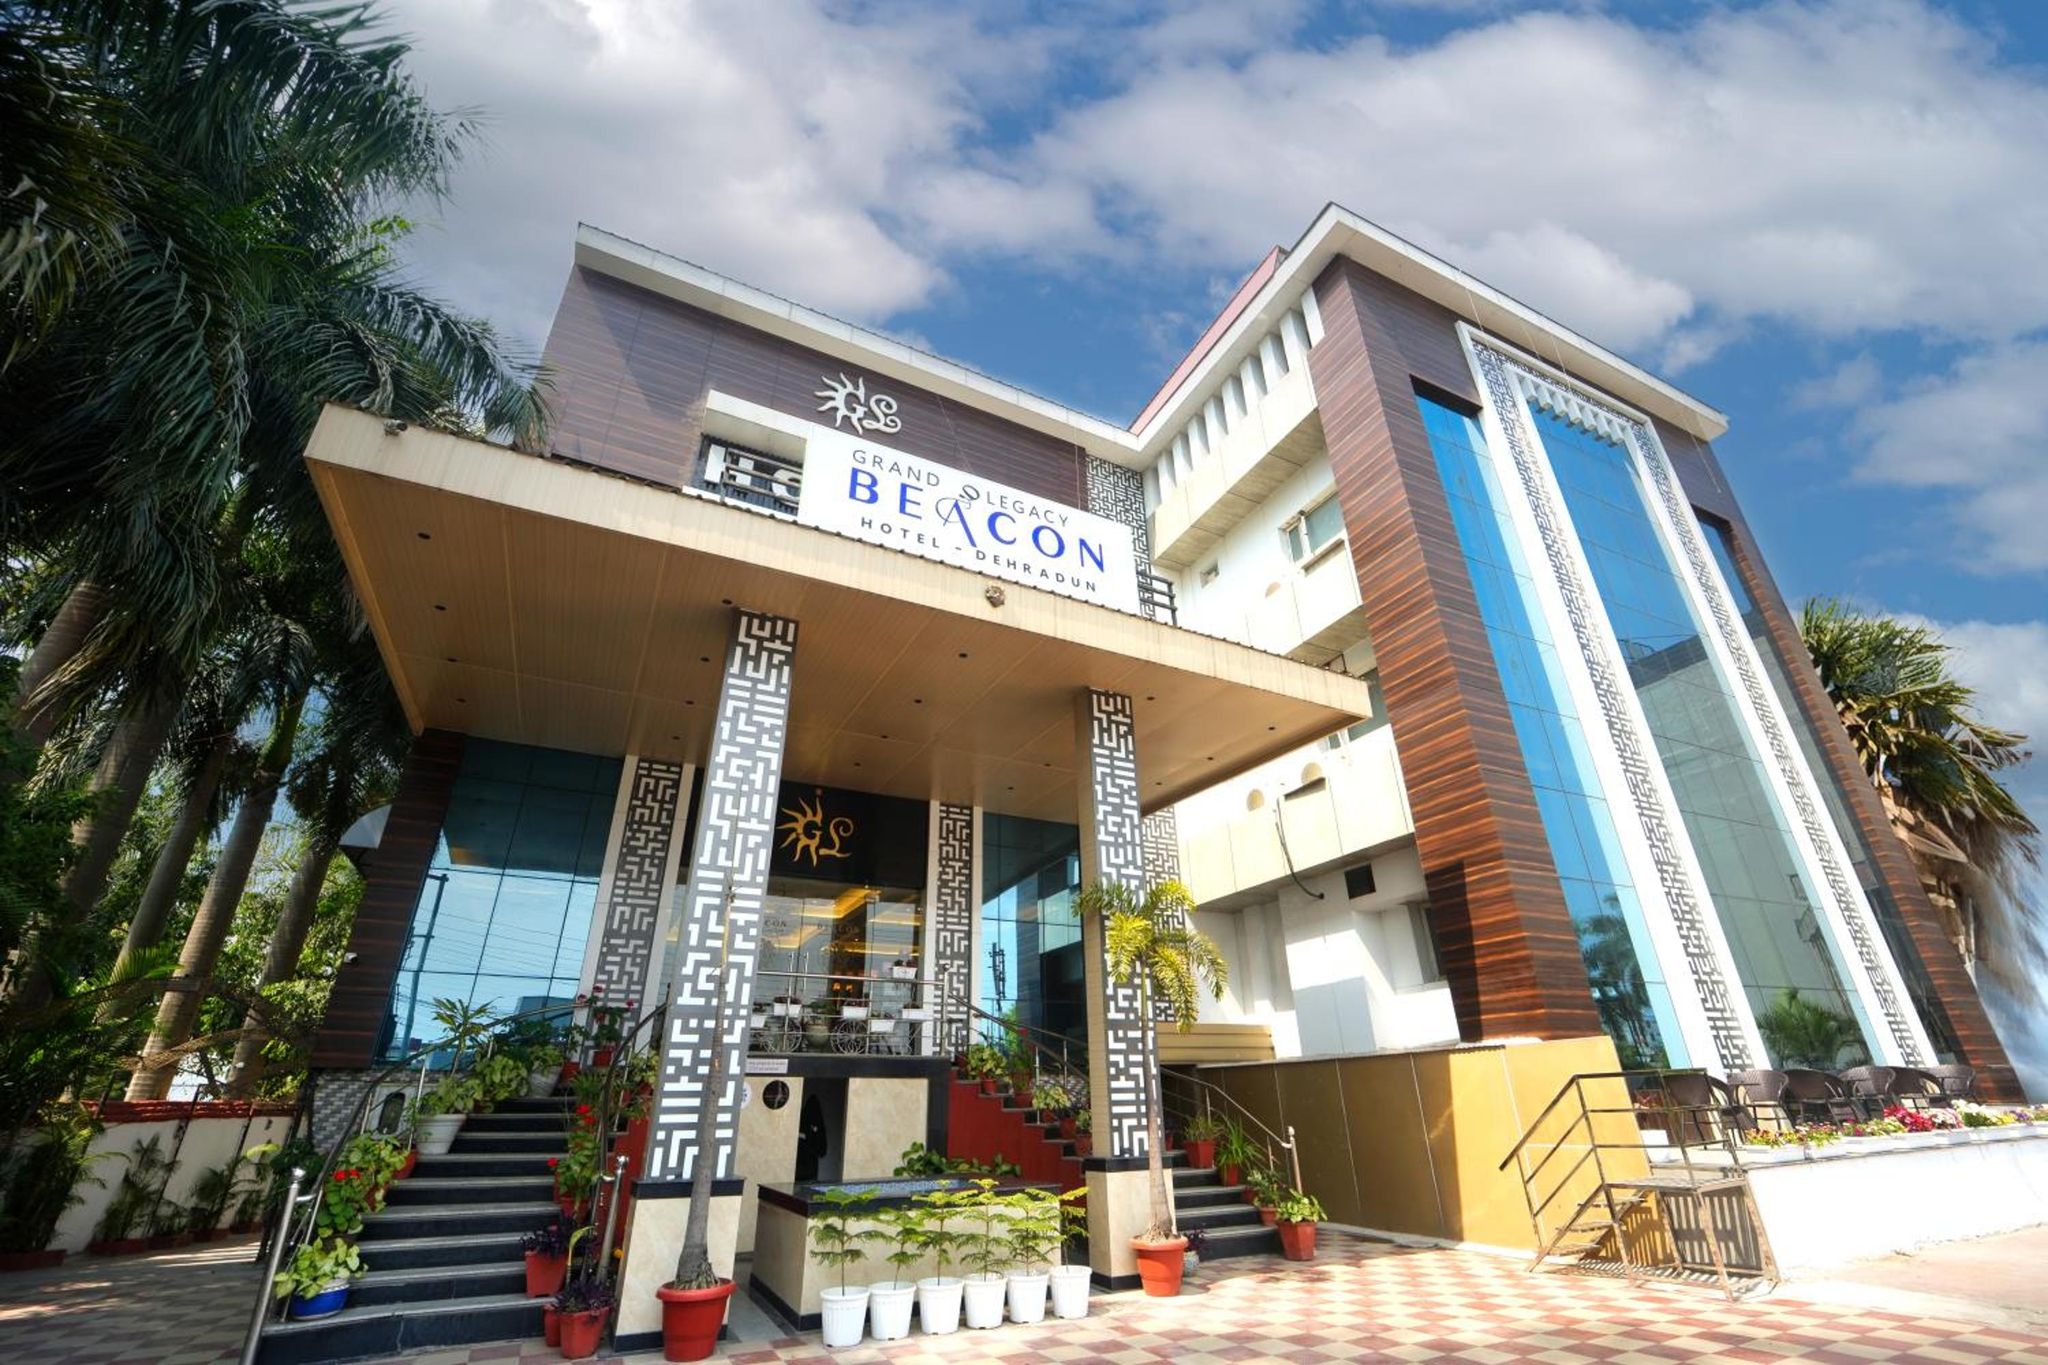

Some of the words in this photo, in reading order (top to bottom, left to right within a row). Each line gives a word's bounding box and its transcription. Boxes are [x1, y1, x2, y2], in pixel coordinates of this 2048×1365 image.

[849, 467, 1104, 573] BEACON
[852, 449, 940, 487] GRAND
[987, 491, 1068, 527] LEGACY
[861, 517, 940, 548] HOTEL
[976, 550, 1096, 592] DEHRADUN
